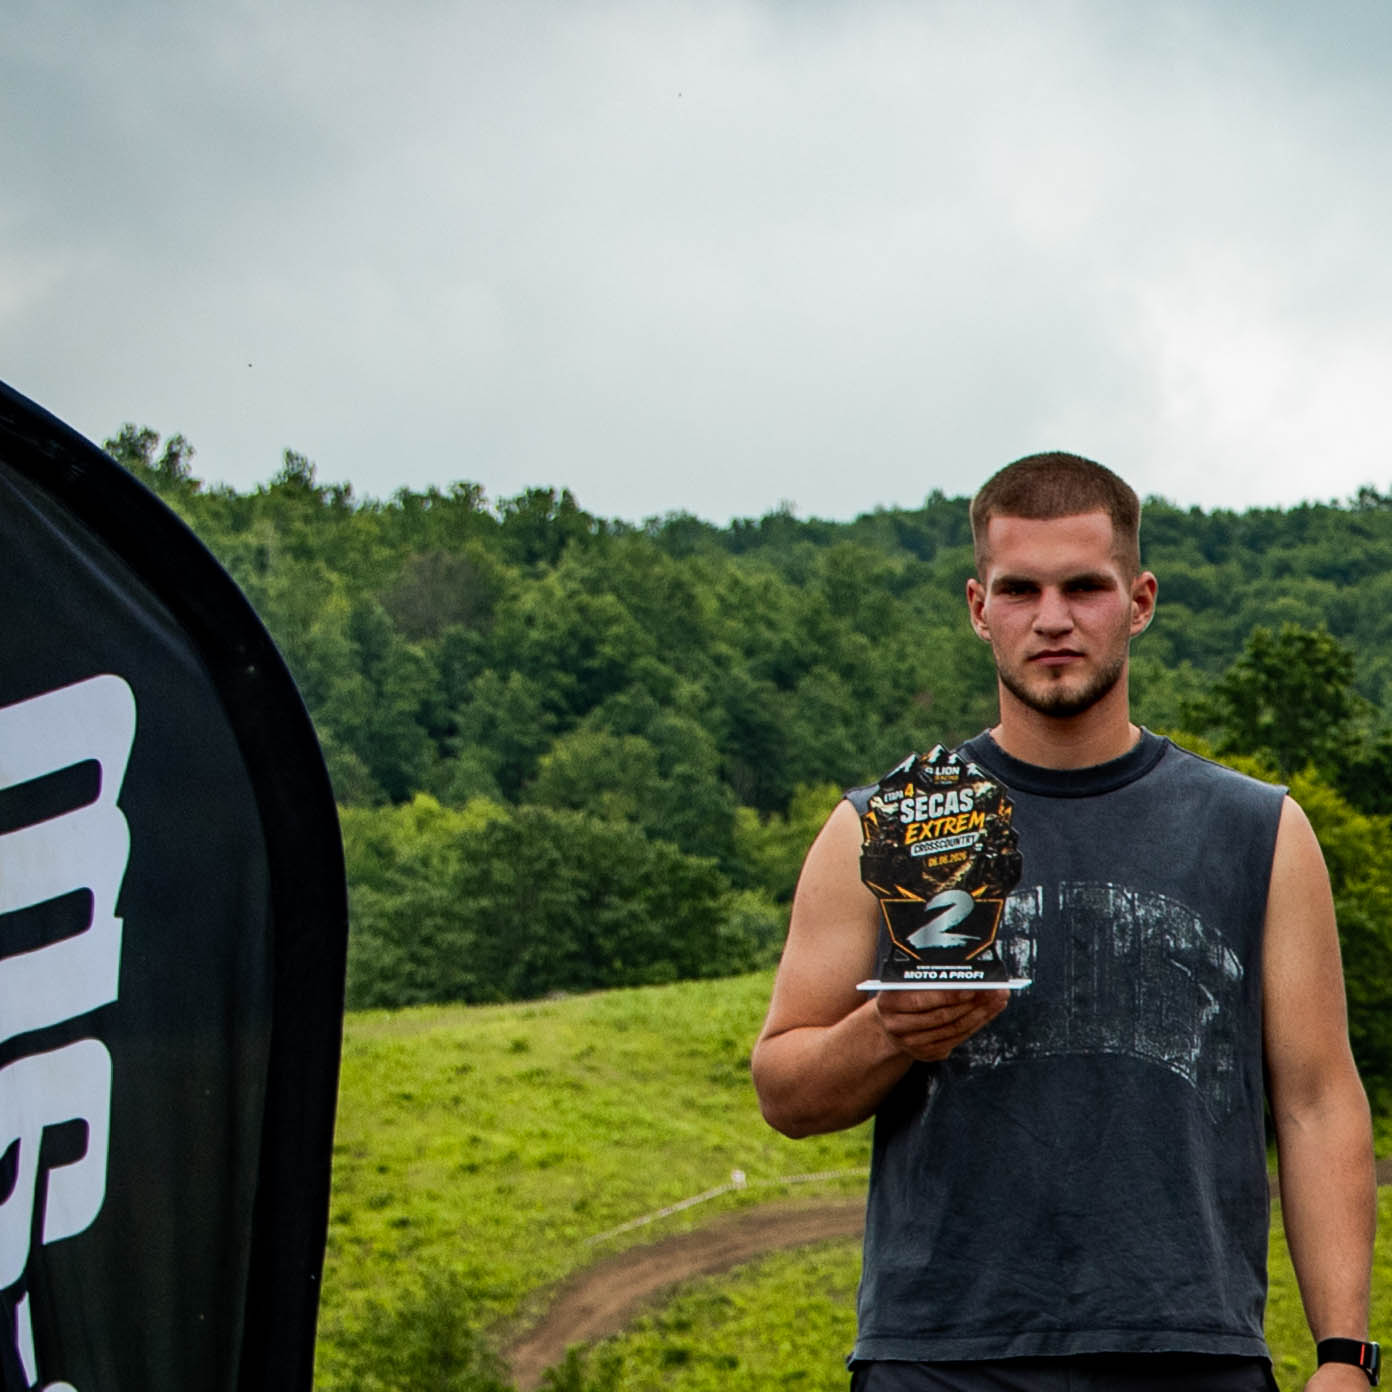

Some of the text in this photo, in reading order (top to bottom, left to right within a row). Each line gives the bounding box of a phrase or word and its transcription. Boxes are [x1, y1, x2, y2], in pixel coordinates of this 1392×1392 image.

[936, 766, 960, 776] LION
[904, 783, 915, 798] 4
[900, 788, 974, 824] SECAS
[905, 810, 986, 845] EXTREM
[906, 889, 982, 950] 2
[903, 970, 985, 979] MOTO A PROFI
